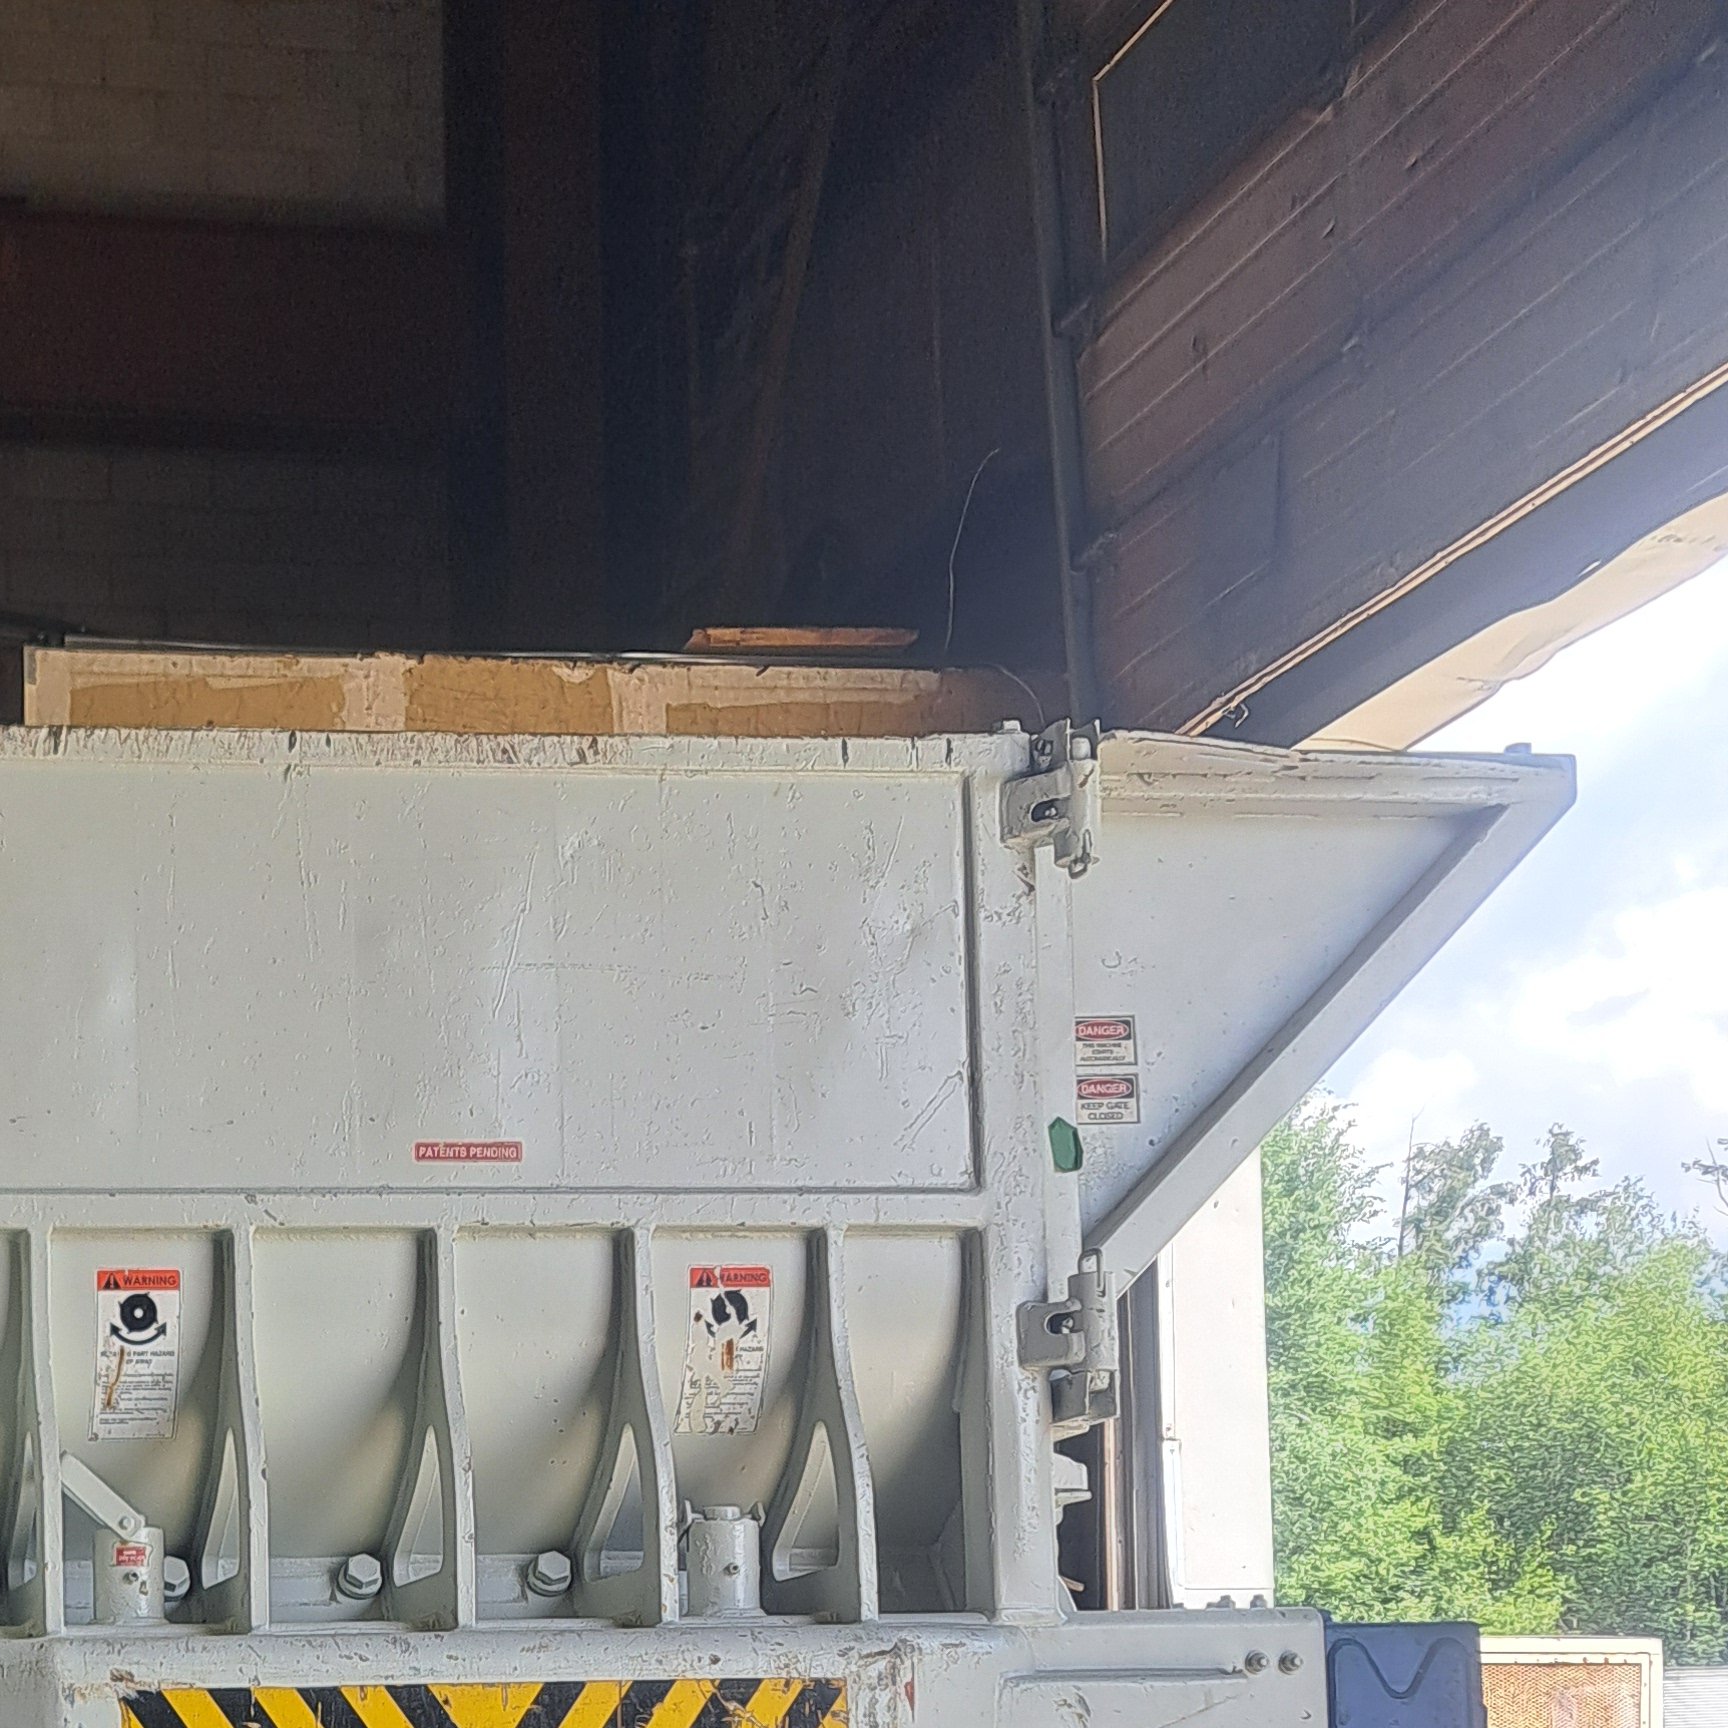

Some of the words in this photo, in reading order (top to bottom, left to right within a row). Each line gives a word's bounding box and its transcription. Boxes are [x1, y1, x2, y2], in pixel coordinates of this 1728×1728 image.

[1077, 1025, 1124, 1036] DANGER
[1080, 1083, 1127, 1094] DANGER
[1081, 1102, 1104, 1110] KEEP
[1106, 1102, 1129, 1110] GATE
[1087, 1111, 1124, 1120] CLOSED
[418, 1146, 467, 1158] PATENTS
[469, 1146, 517, 1158] PENDING
[123, 1274, 177, 1286] WARNING
